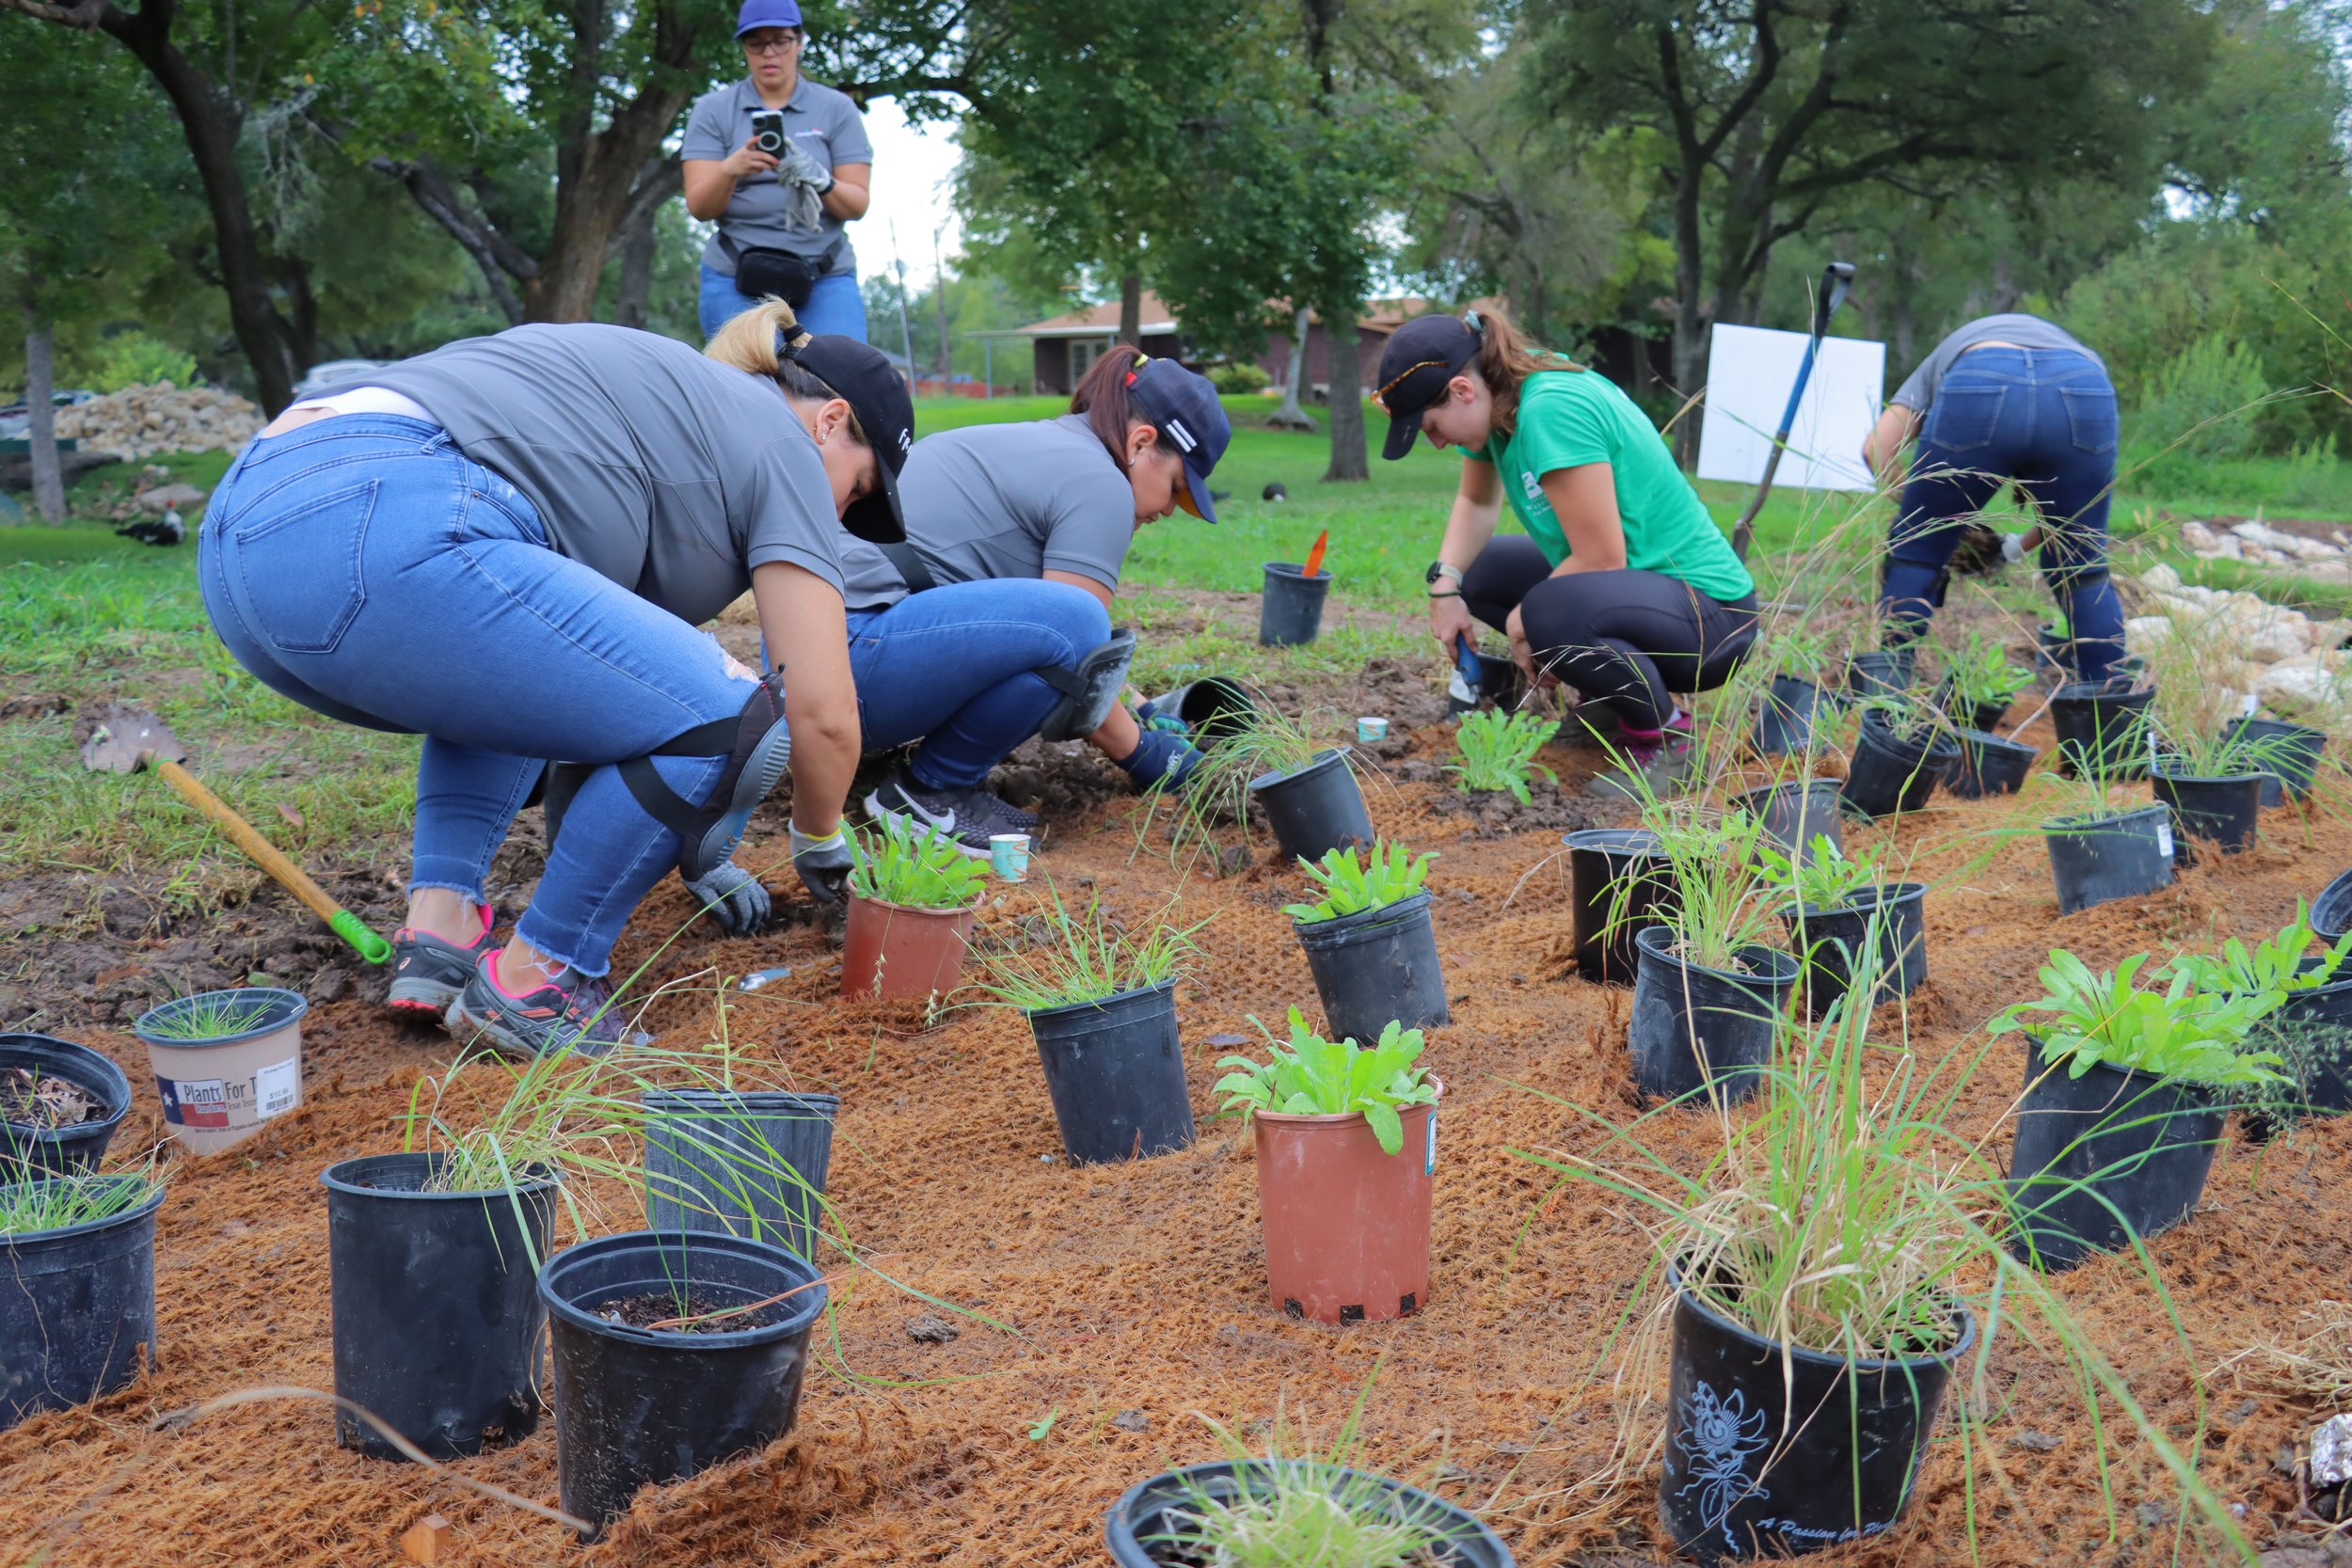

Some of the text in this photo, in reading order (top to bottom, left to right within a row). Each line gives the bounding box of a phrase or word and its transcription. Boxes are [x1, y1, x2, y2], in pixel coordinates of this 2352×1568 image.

[183, 1077, 257, 1102] Plants For T
[1756, 1517, 1777, 1528] A
[1778, 1520, 1836, 1539] Passion
